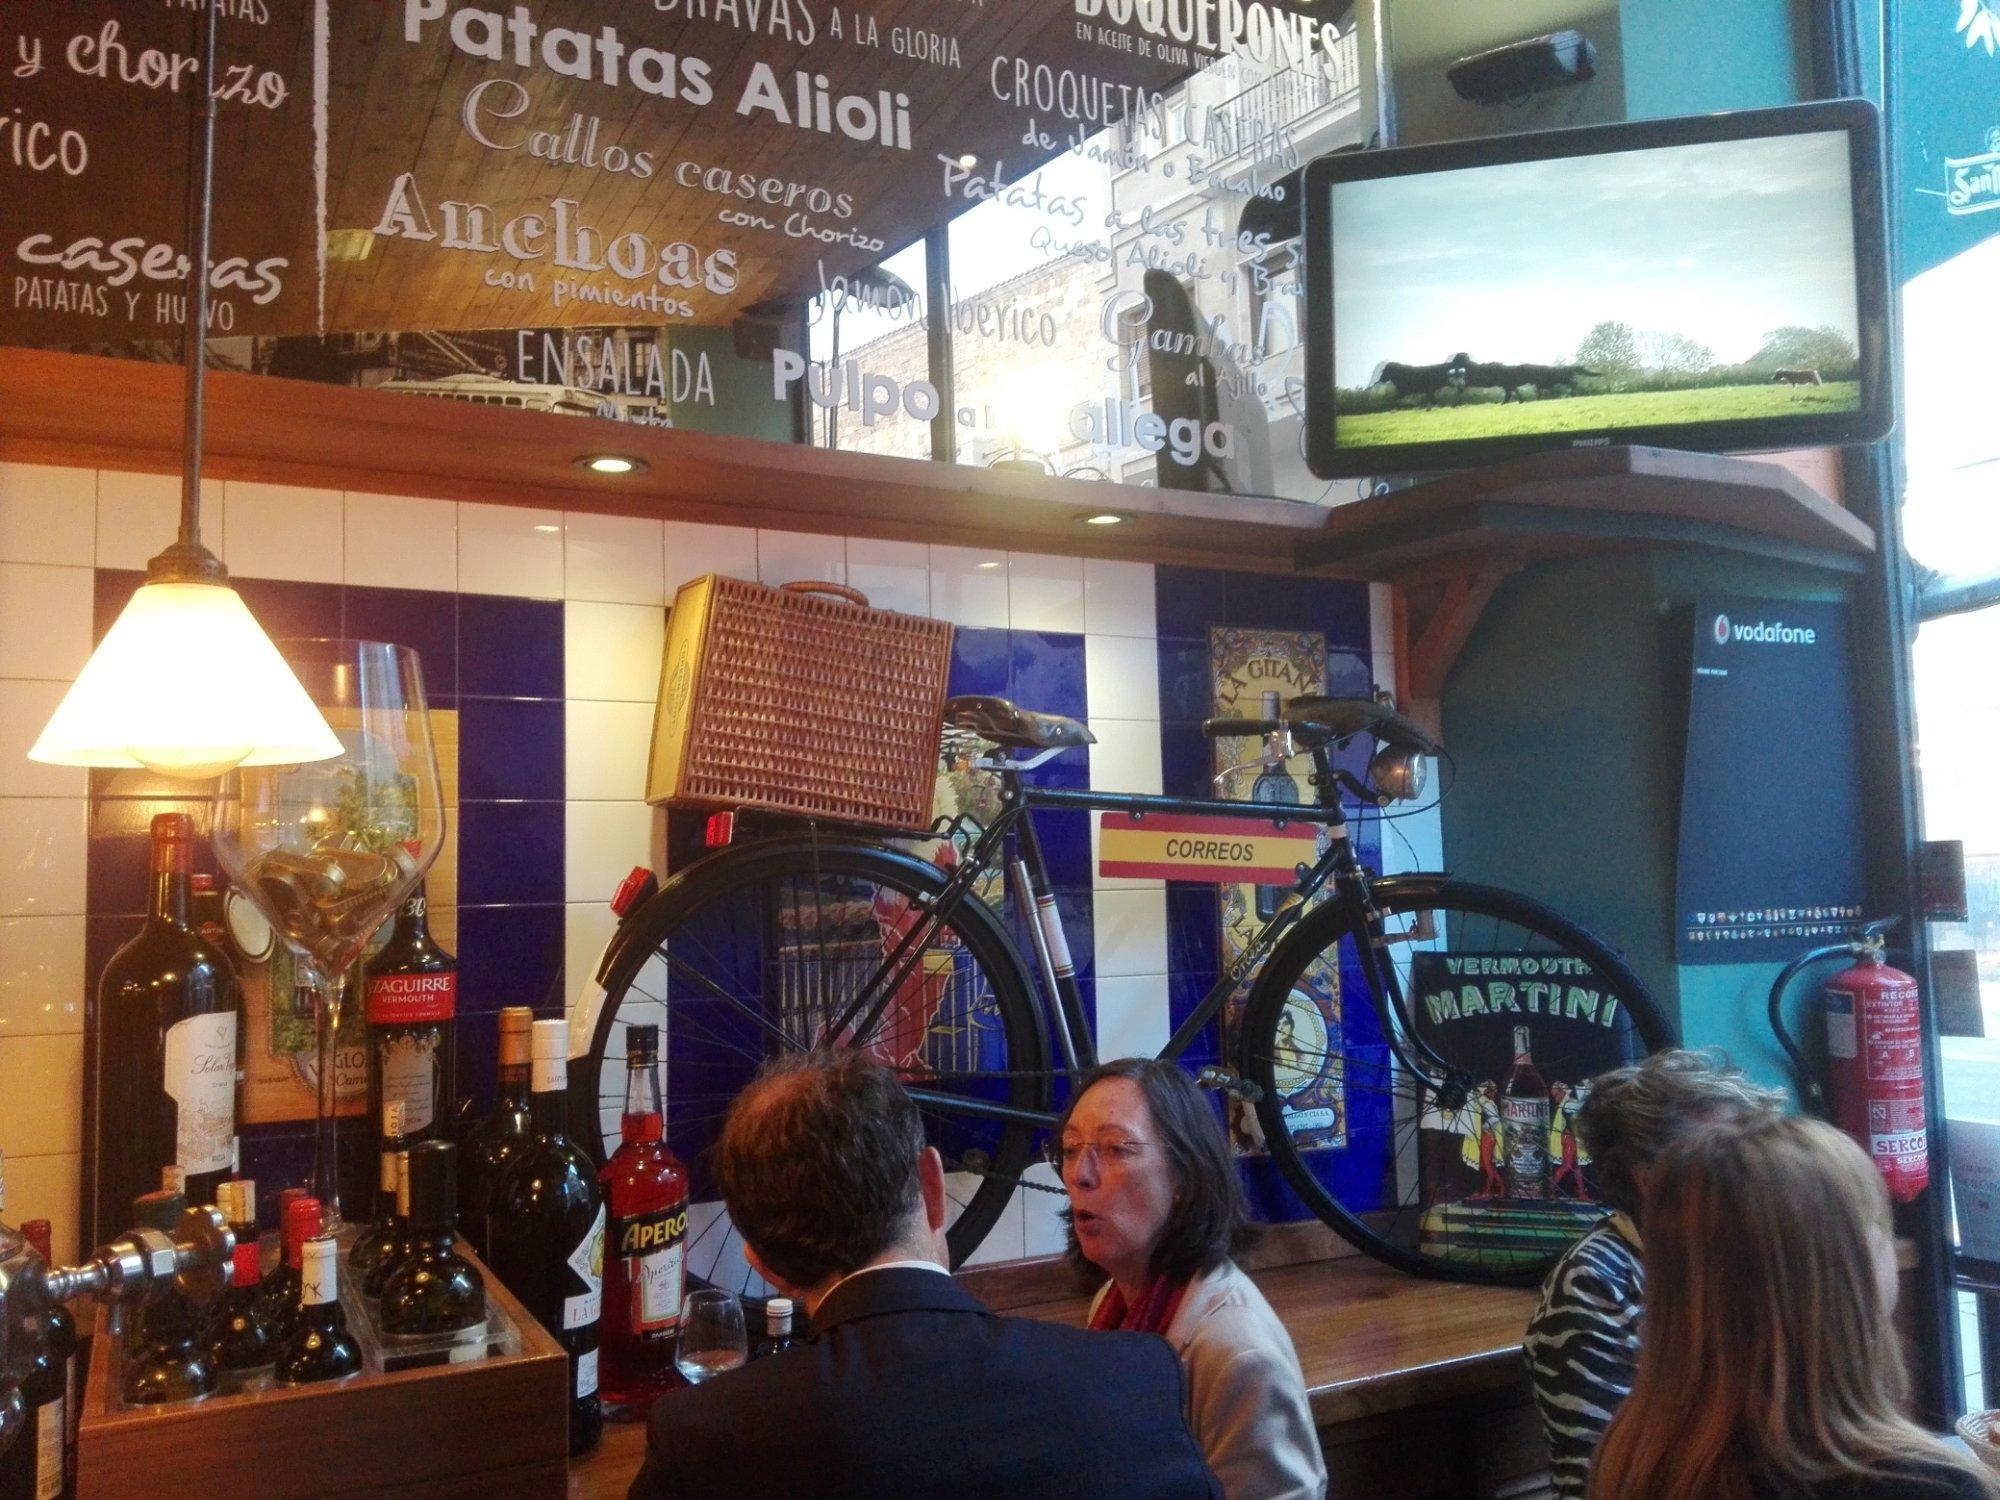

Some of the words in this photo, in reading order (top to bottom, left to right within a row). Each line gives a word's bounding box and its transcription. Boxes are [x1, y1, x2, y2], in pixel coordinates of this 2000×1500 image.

[830, 7, 843, 39] A
[855, 15, 879, 48] LA
[892, 27, 961, 68] GLORIA
[1076, 22, 1092, 41] EN
[1097, 27, 1132, 53] ACEITE
[1137, 38, 1151, 58] DE
[1157, 44, 1188, 67] OLIVA
[14, 35, 44, 77] y
[66, 20, 289, 109] chorzo
[404, 0, 714, 106] Patatas
[736, 62, 911, 150] Alioli
[991, 56, 1164, 141] CROQUETAS
[1184, 102, 1299, 171] CASERAS
[463, 79, 654, 179] Callos
[675, 161, 855, 218] caseros
[1022, 118, 1056, 149] de
[1163, 161, 1175, 178] o
[718, 209, 775, 231] con
[784, 213, 885, 252] Chorizo
[937, 152, 1088, 226] Patatas
[1105, 210, 1129, 229] a
[1201, 206, 1271, 263] tres
[372, 172, 739, 295] Anchoas
[1126, 241, 1210, 279] Alioli
[14, 276, 107, 317] PATATAS
[125, 292, 140, 320] Y
[156, 292, 234, 331] HUVO
[484, 268, 534, 292] con
[554, 279, 694, 318] pimientos
[518, 330, 715, 406] ENSALADA
[773, 348, 940, 427] Pulpo
[1185, 362, 1204, 387] al
[1734, 621, 1816, 644] vodafone
[1220, 674, 1248, 706] LA
[1247, 658, 1318, 697] GITAN
[1166, 838, 1255, 862] CORREOS
[1446, 957, 1593, 976] VERMOUTH
[382, 994, 434, 1003] VERMOUTH
[1425, 981, 1618, 1028] MARTINI
[621, 1212, 688, 1252] APERO
